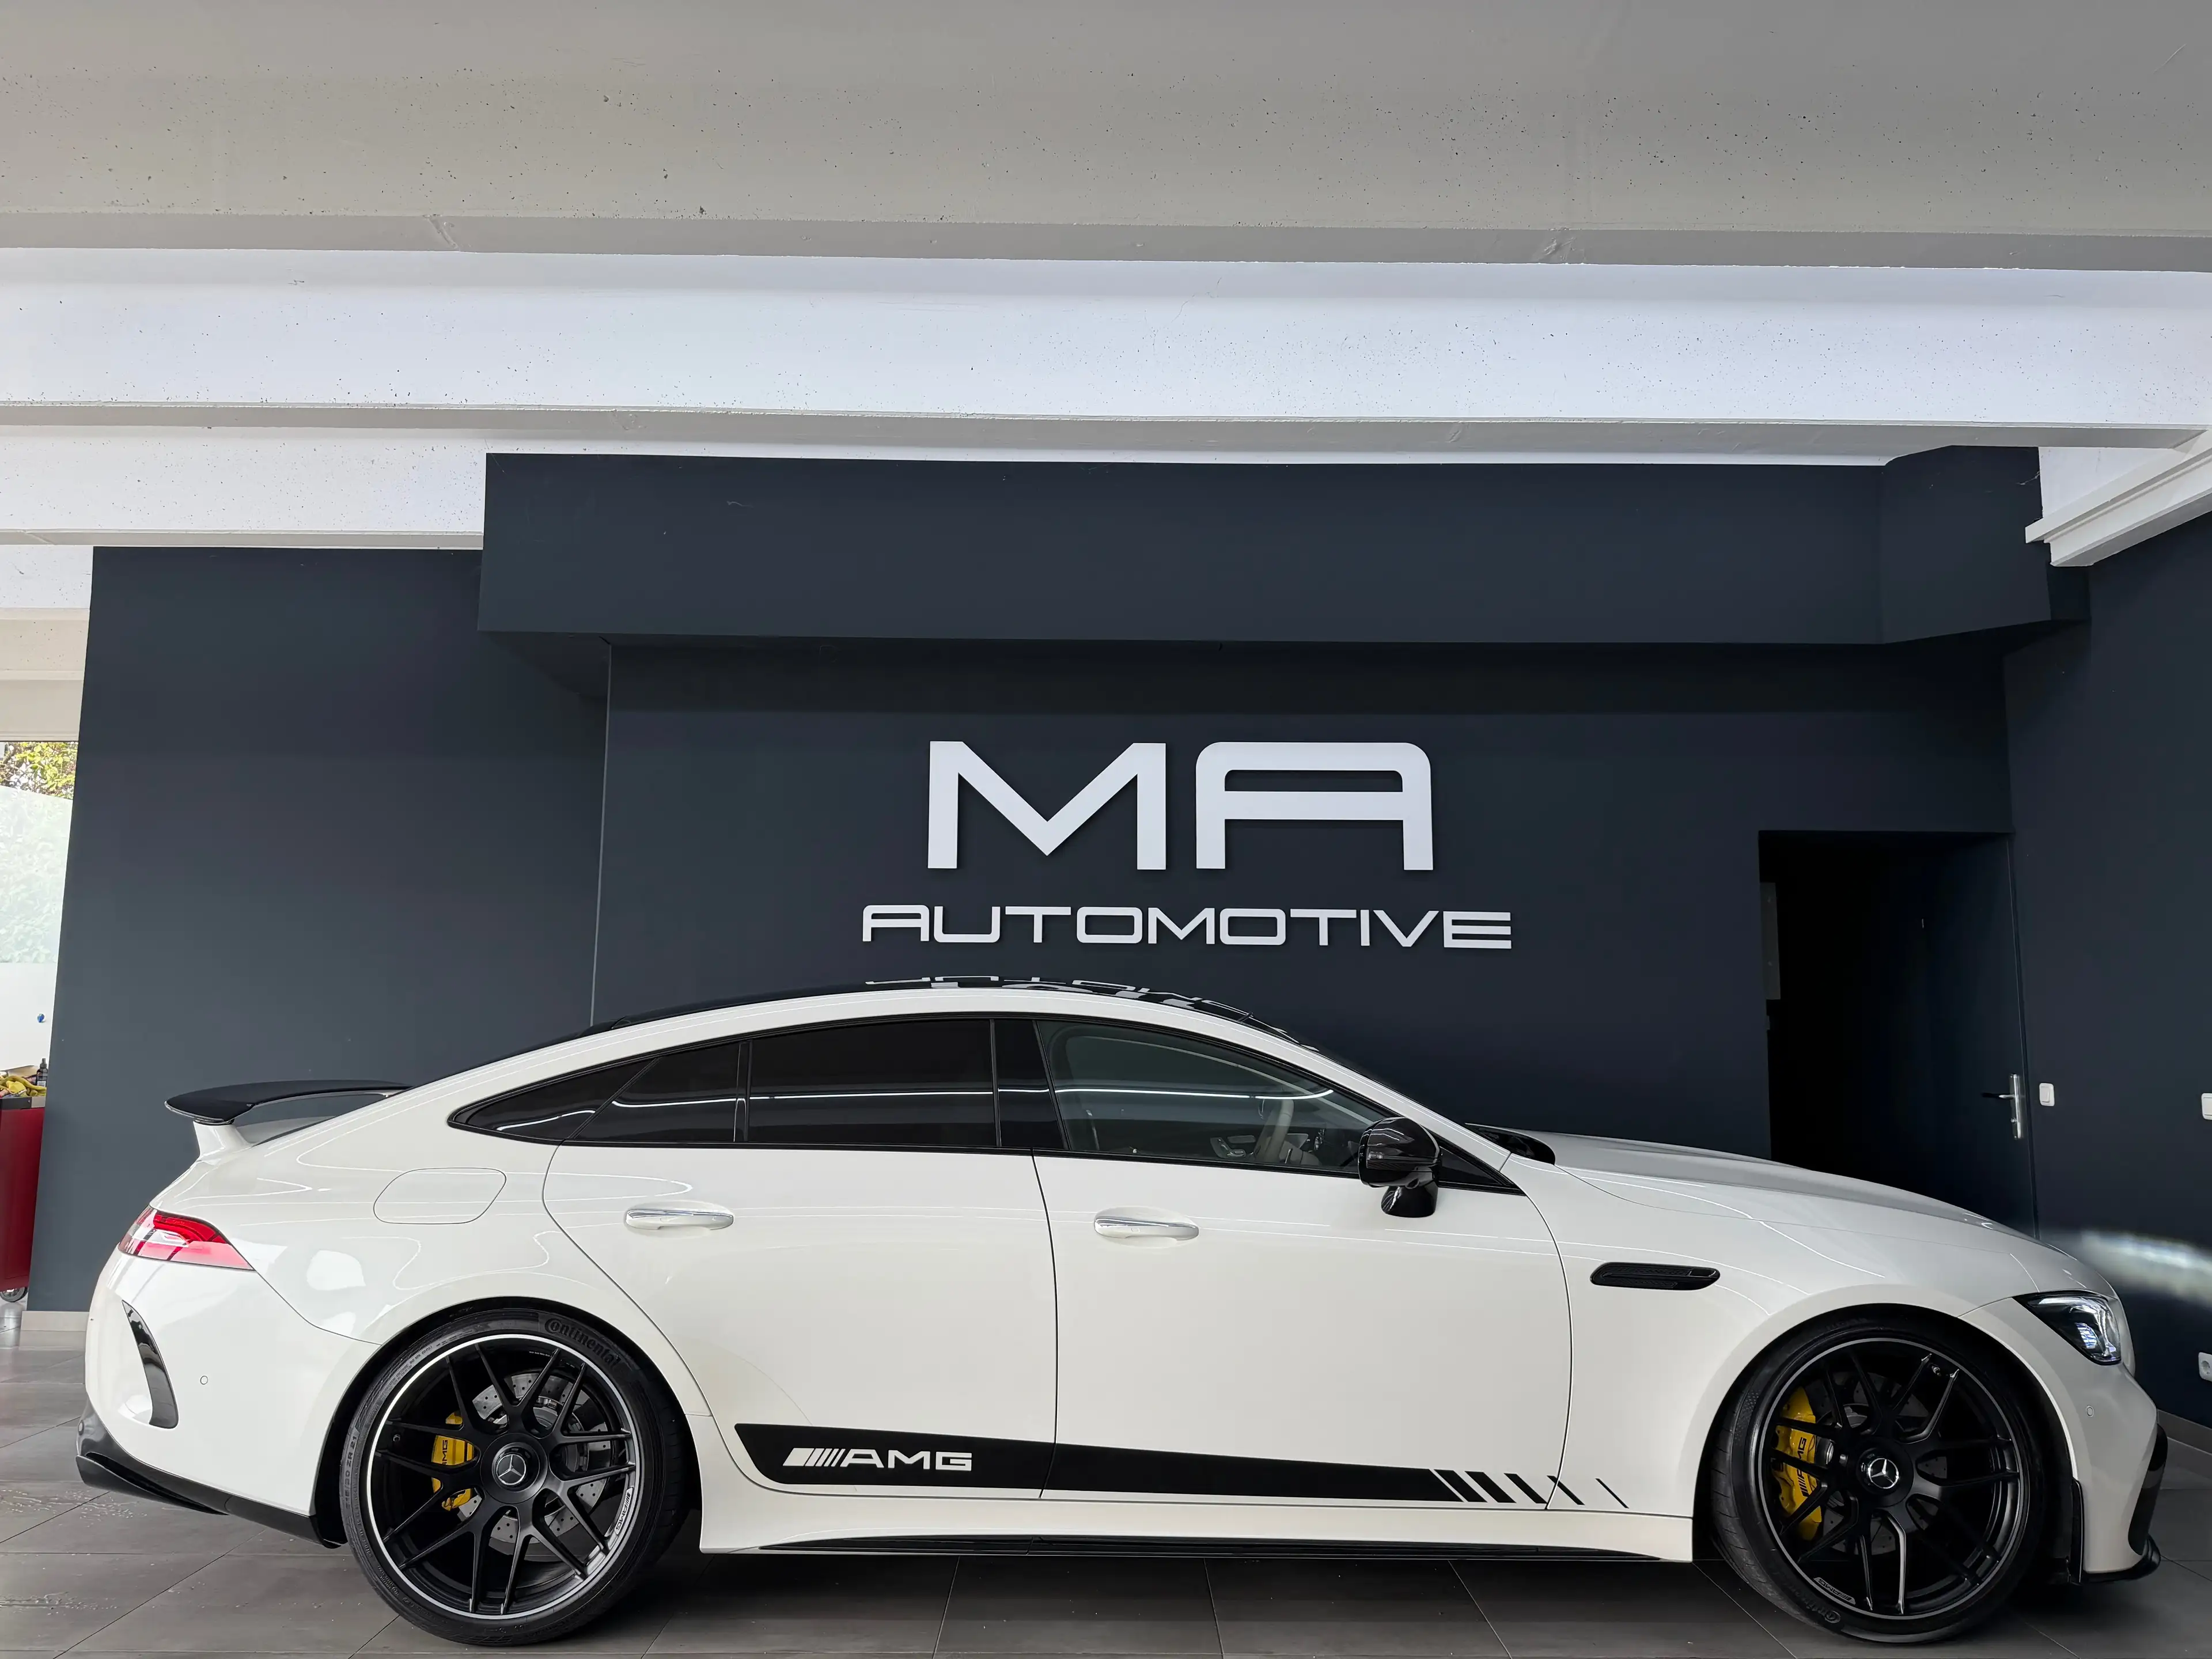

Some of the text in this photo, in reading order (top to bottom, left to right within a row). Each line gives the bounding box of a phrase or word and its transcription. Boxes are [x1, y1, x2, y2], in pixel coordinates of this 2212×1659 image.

[928, 741, 1433, 870] MA
[863, 905, 1512, 949] AUTOMOTIVE
[544, 1318, 621, 1366] Continental
[840, 1449, 972, 1471] AMG
[615, 1503, 628, 1531] AMG
[1819, 1578, 1843, 1596] AMG
